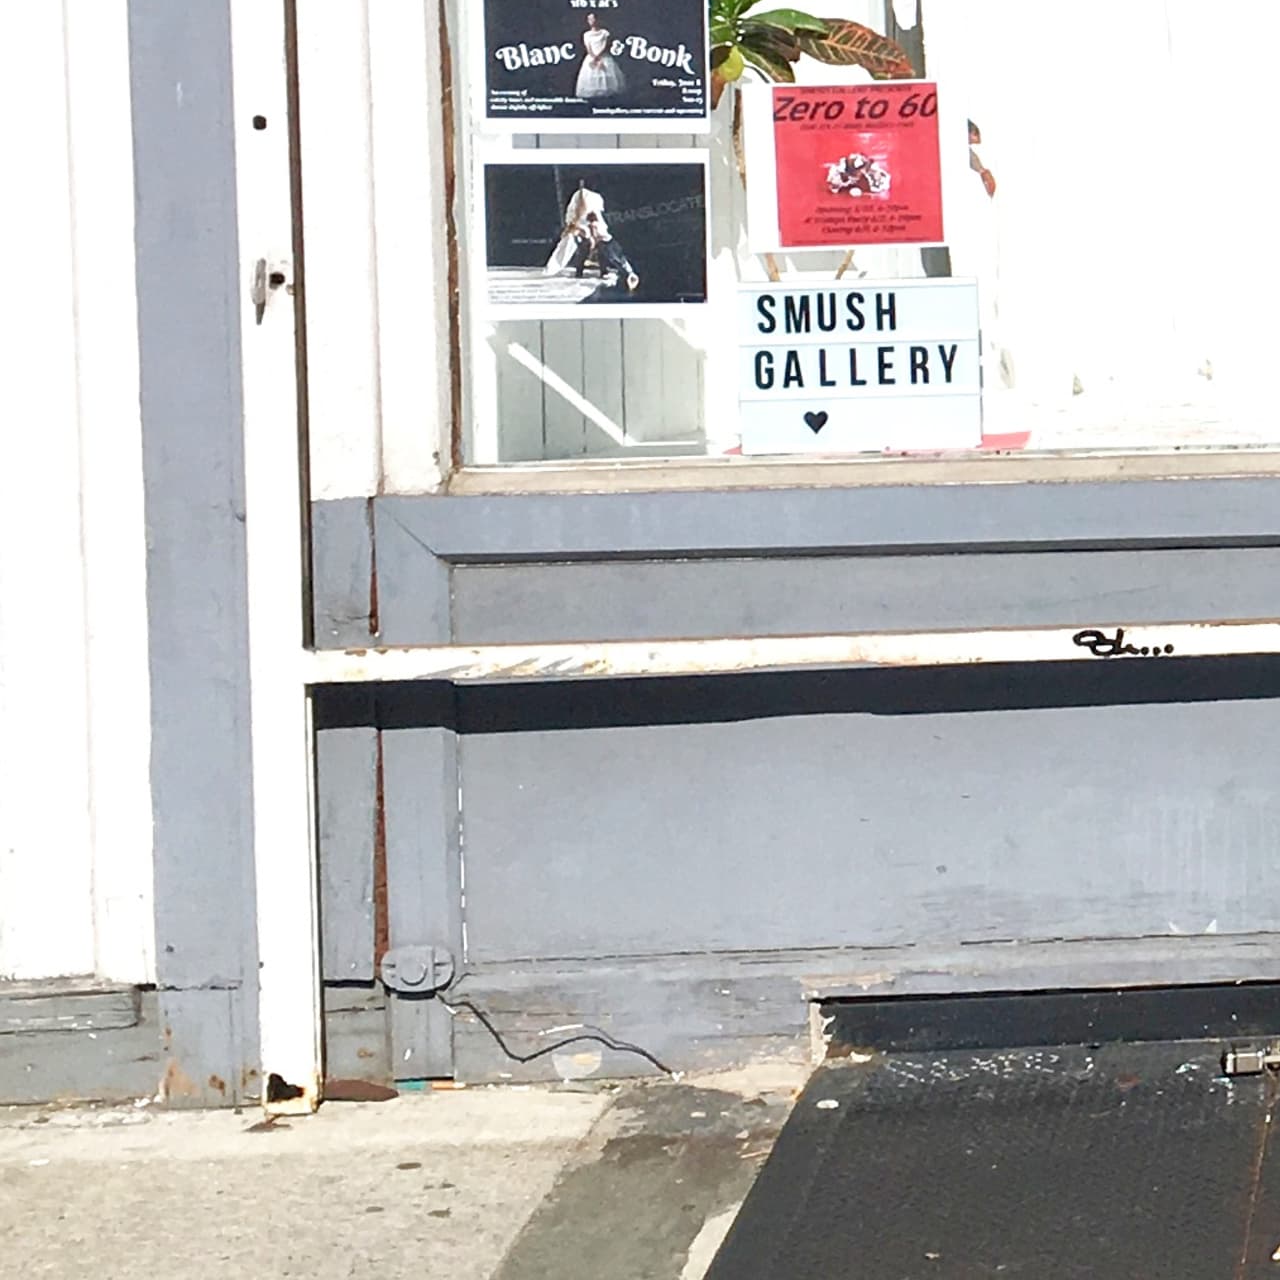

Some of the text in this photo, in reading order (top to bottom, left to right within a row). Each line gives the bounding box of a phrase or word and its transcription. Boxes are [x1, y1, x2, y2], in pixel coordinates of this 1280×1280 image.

[495, 35, 696, 75] Blanc & Bonk
[773, 91, 937, 122] Zero to 60
[756, 291, 897, 334] SMUSH
[754, 344, 958, 390] GALLERY
